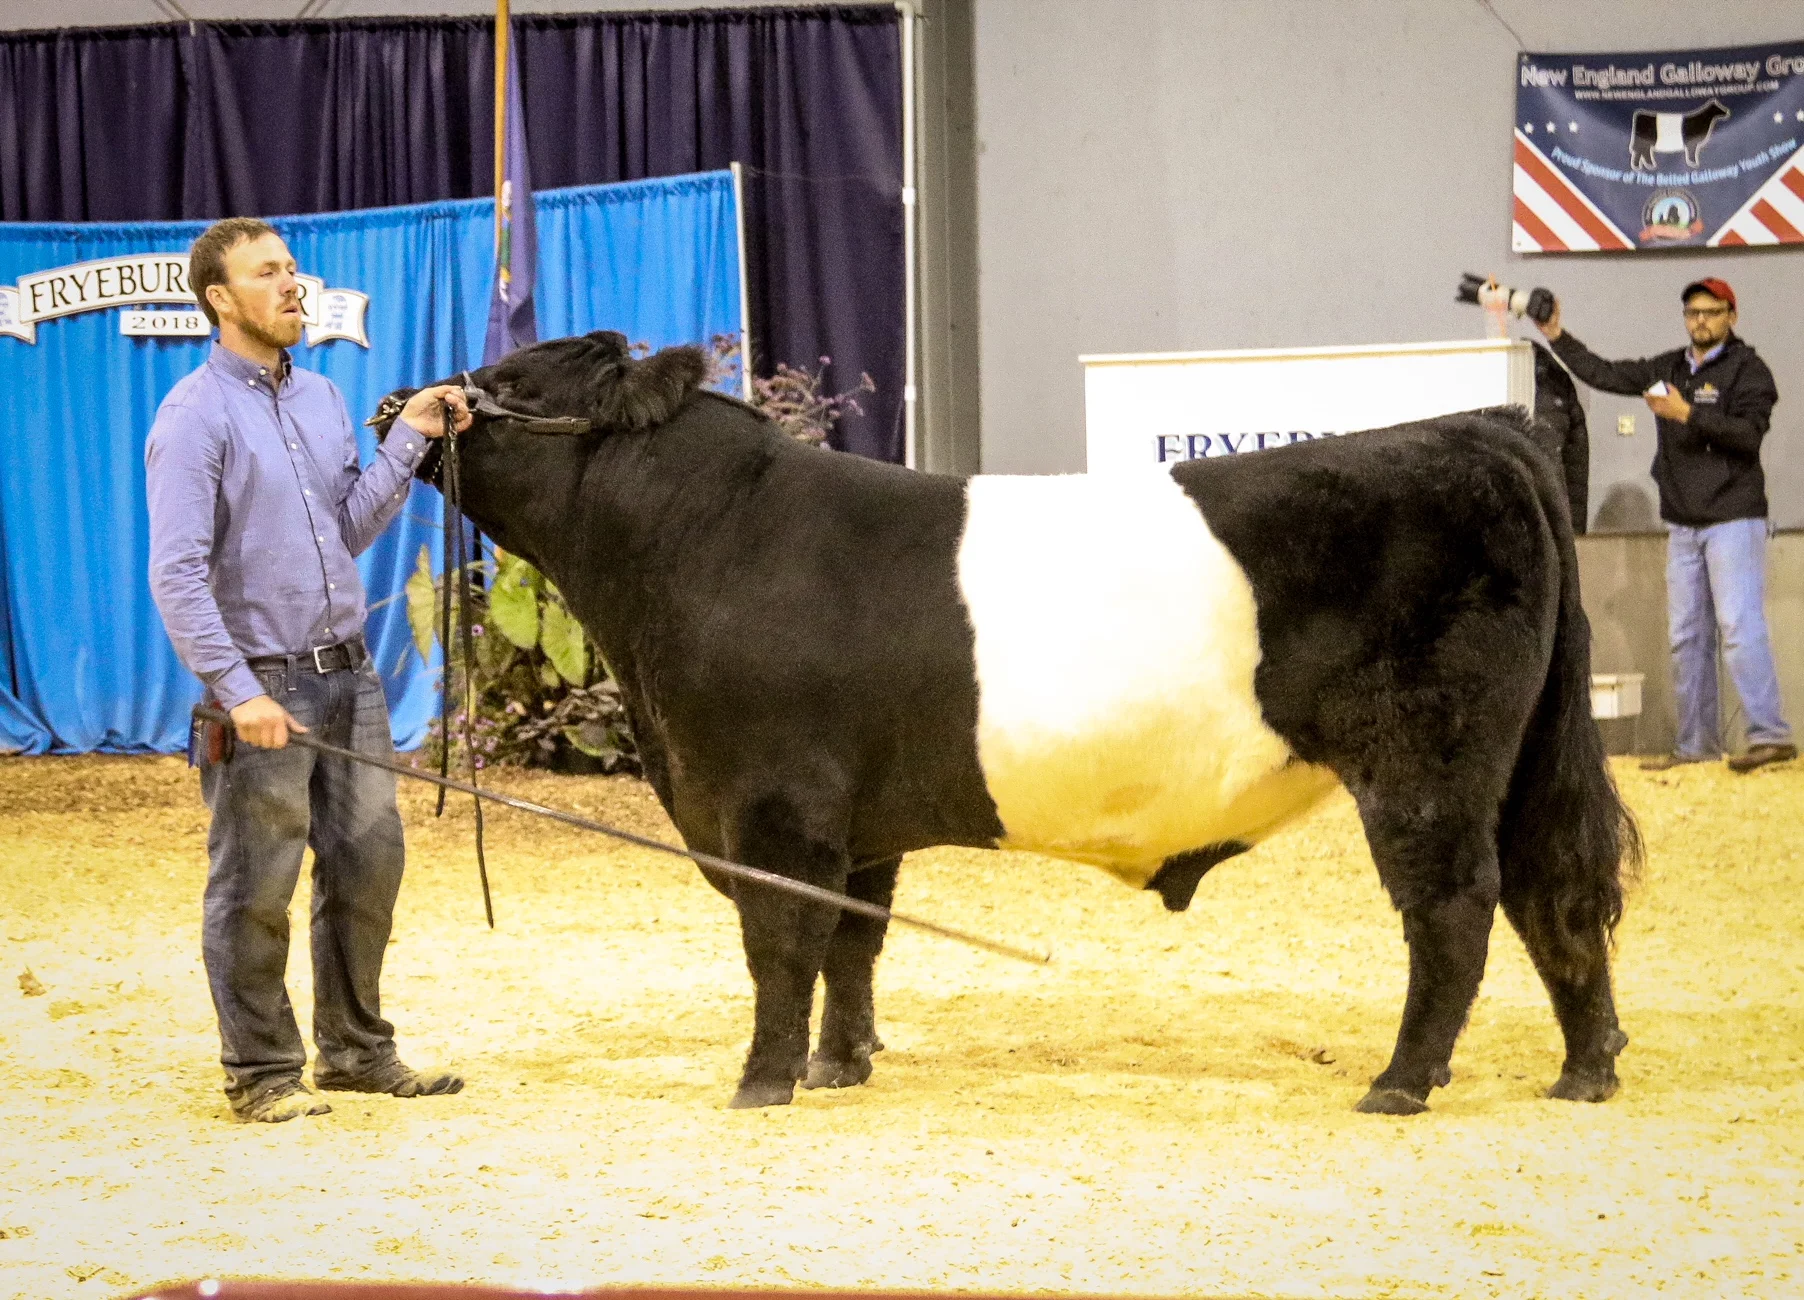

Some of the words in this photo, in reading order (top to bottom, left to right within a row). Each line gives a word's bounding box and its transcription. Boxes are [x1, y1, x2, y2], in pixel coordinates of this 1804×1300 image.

[1521, 64, 1568, 87] New
[1572, 63, 1654, 90] England
[1660, 60, 1760, 85] Galloway
[1551, 146, 1581, 170] Proud
[1580, 158, 1623, 181] Sponsor
[1623, 171, 1635, 184] of
[1690, 163, 1739, 184] Galloway
[1738, 151, 1770, 172] Youth
[1768, 137, 1797, 161] Show
[29, 262, 195, 313] FRYEBUR
[131, 316, 199, 330] 2018
